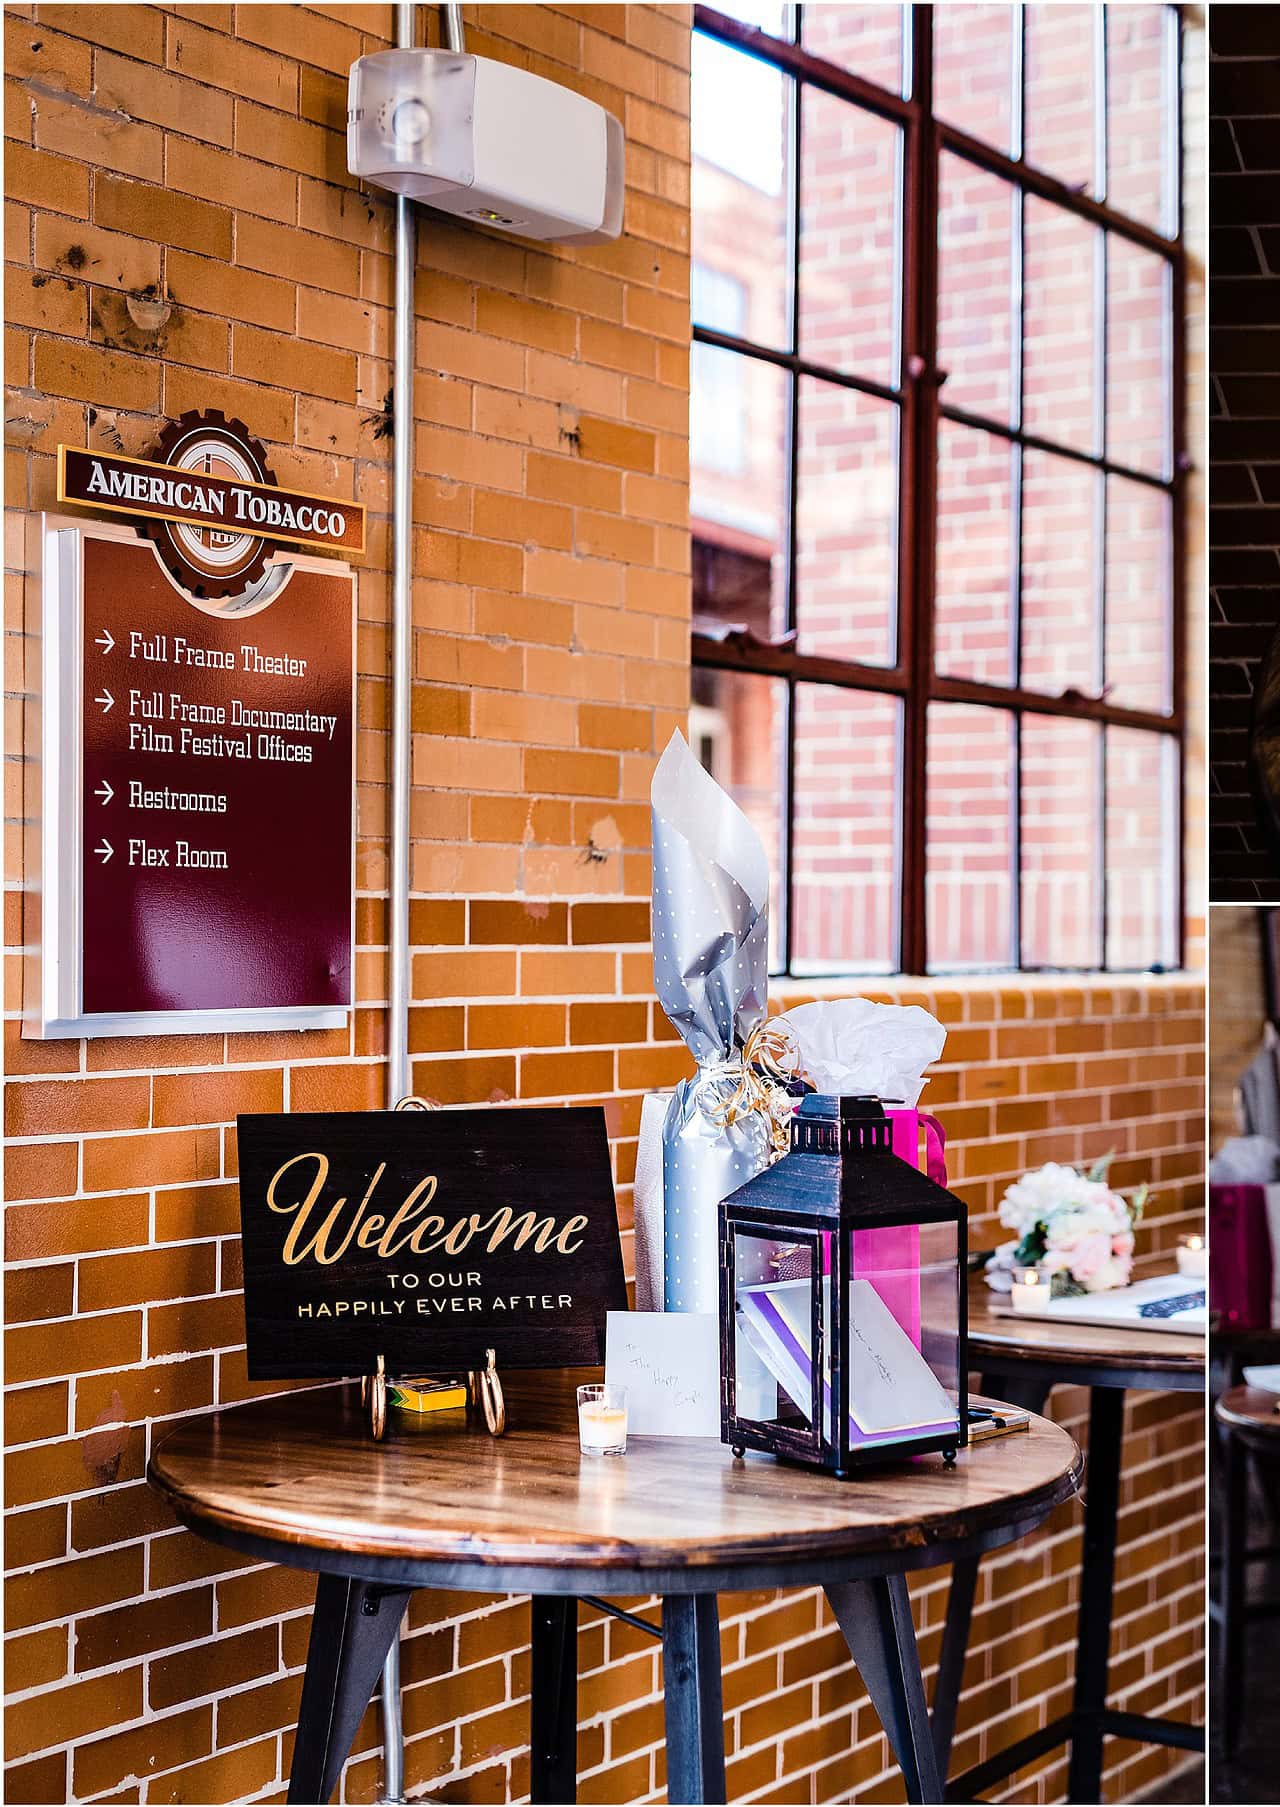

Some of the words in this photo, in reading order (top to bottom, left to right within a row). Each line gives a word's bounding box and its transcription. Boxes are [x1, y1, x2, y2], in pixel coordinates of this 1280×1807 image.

[87, 461, 226, 516] AMERICAN
[230, 488, 346, 537] TOBACCO
[129, 632, 167, 661] Full
[174, 638, 235, 669] Frame
[241, 646, 307, 677] Theater
[129, 690, 163, 719] Full
[170, 694, 225, 725] Frame
[231, 701, 337, 740] Documentary
[129, 723, 173, 752] Film
[181, 728, 252, 759] Festival
[258, 735, 312, 762] Offices
[129, 781, 227, 812] Restrooms
[128, 840, 169, 866] Flex
[176, 841, 228, 868] Room
[266, 1152, 589, 1265] Welcome
[387, 1274, 418, 1289] TO
[428, 1272, 482, 1287] OUR
[298, 1300, 405, 1318] HAPPILY
[416, 1297, 482, 1315] EVER
[492, 1294, 573, 1311] AFTER
